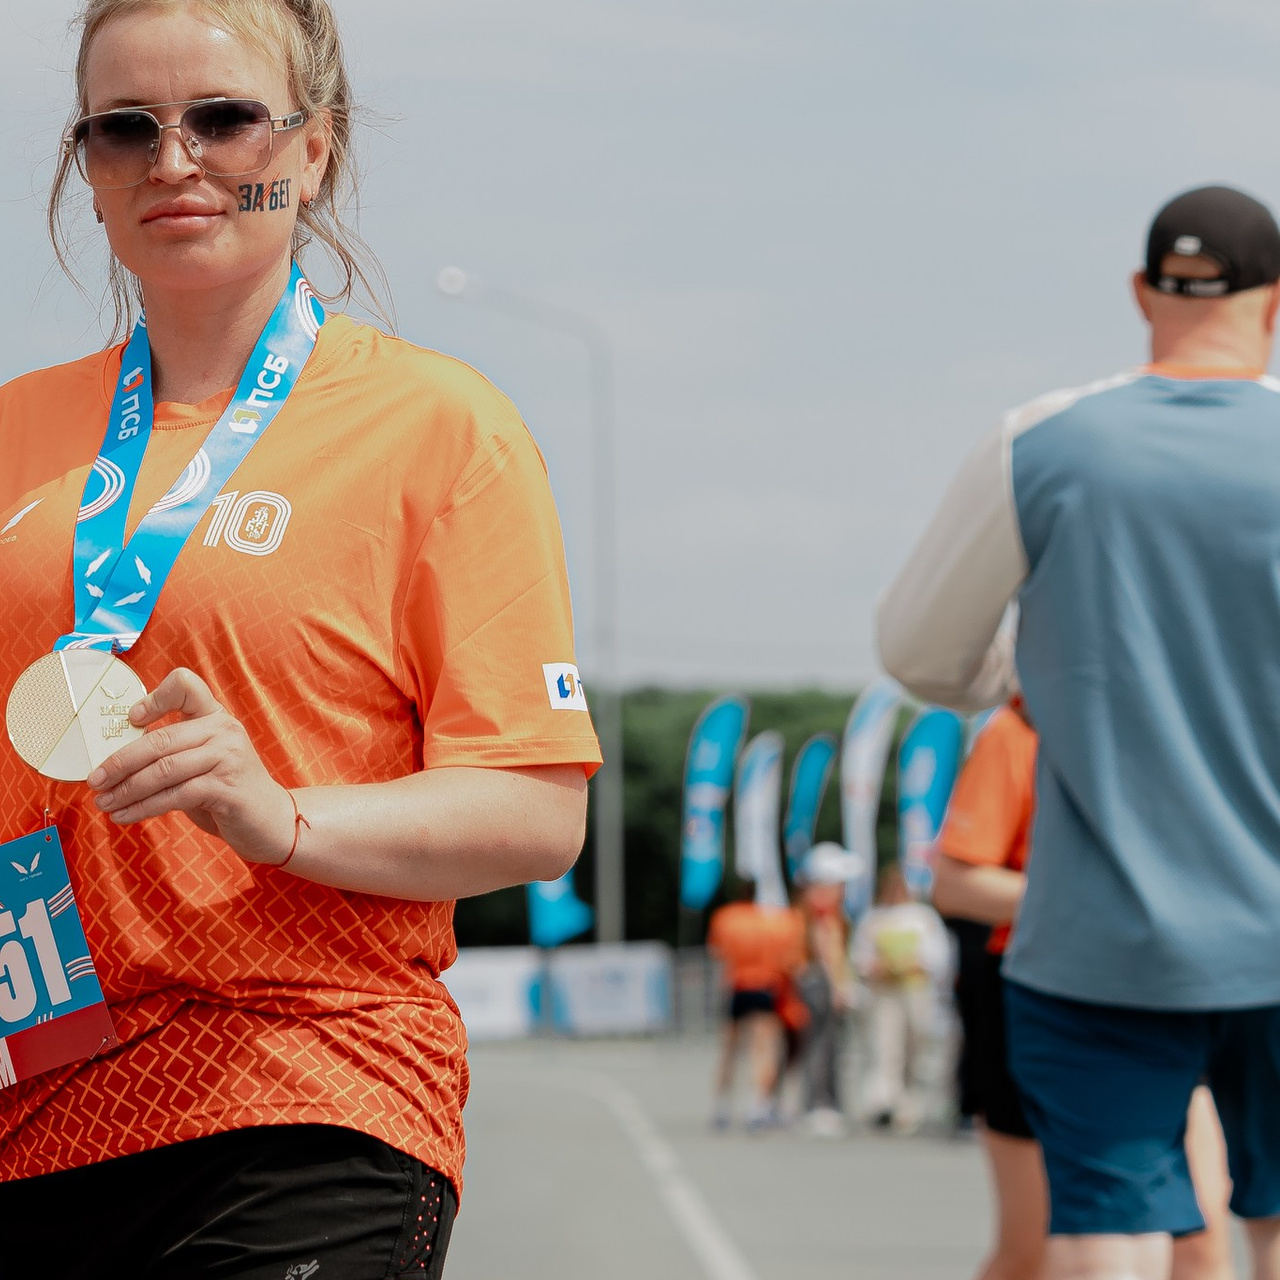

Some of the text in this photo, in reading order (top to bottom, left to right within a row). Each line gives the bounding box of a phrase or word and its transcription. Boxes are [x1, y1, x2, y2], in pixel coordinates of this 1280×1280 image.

[246, 353, 290, 408] ПСБ
[117, 393, 141, 440] ПСБ
[202, 490, 292, 556] 10
